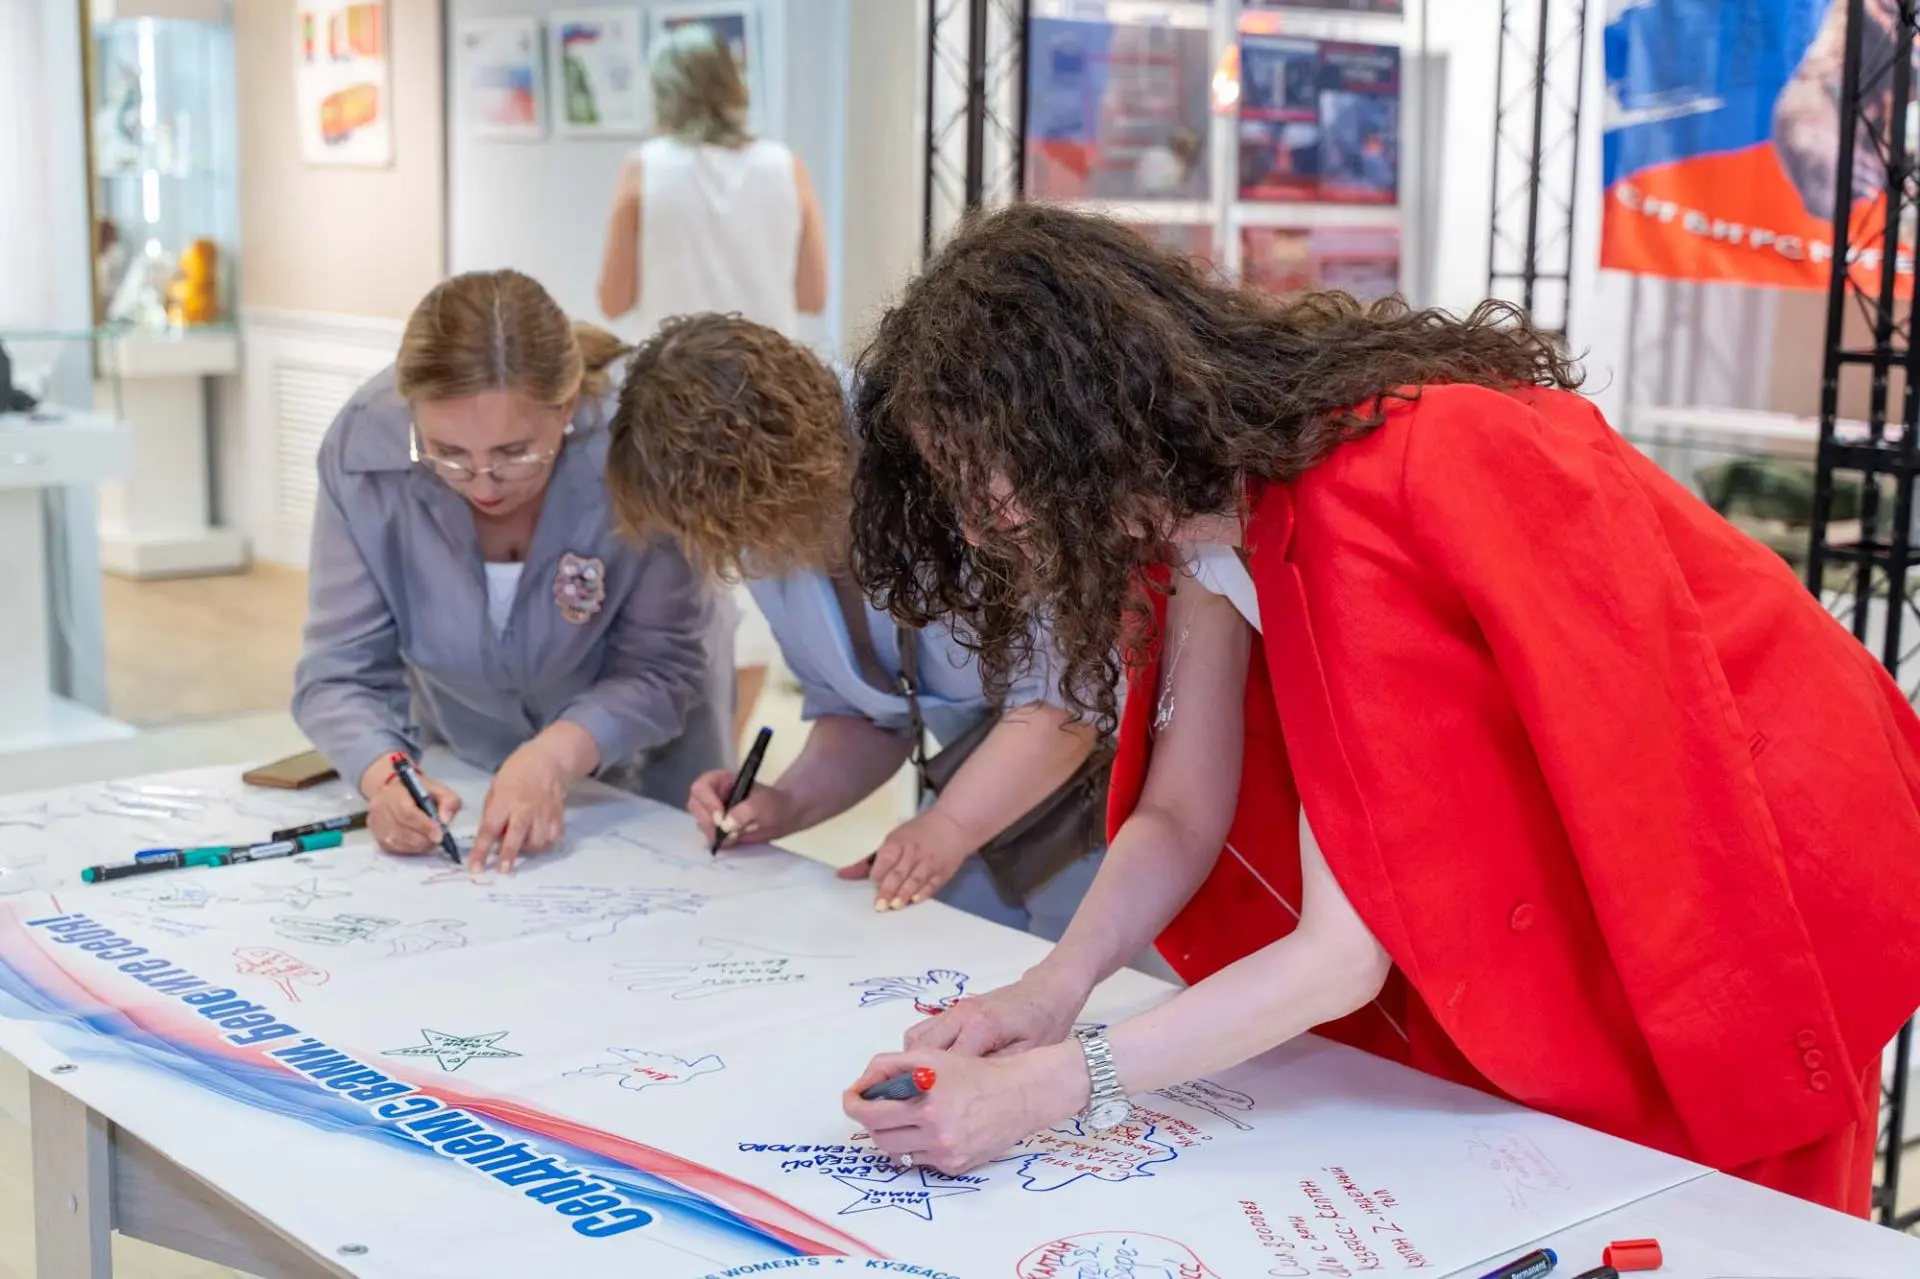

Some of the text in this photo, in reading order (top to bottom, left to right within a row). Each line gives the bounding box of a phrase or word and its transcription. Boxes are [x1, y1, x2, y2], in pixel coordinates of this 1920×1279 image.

[25, 913, 149, 961] себя!
[117, 958, 302, 1048] Береите
[271, 1038, 418, 1102] вами.
[377, 1096, 442, 1119] с
[404, 1108, 653, 1238] Сердцем
[720, 1257, 821, 1277] WOMEN'S
